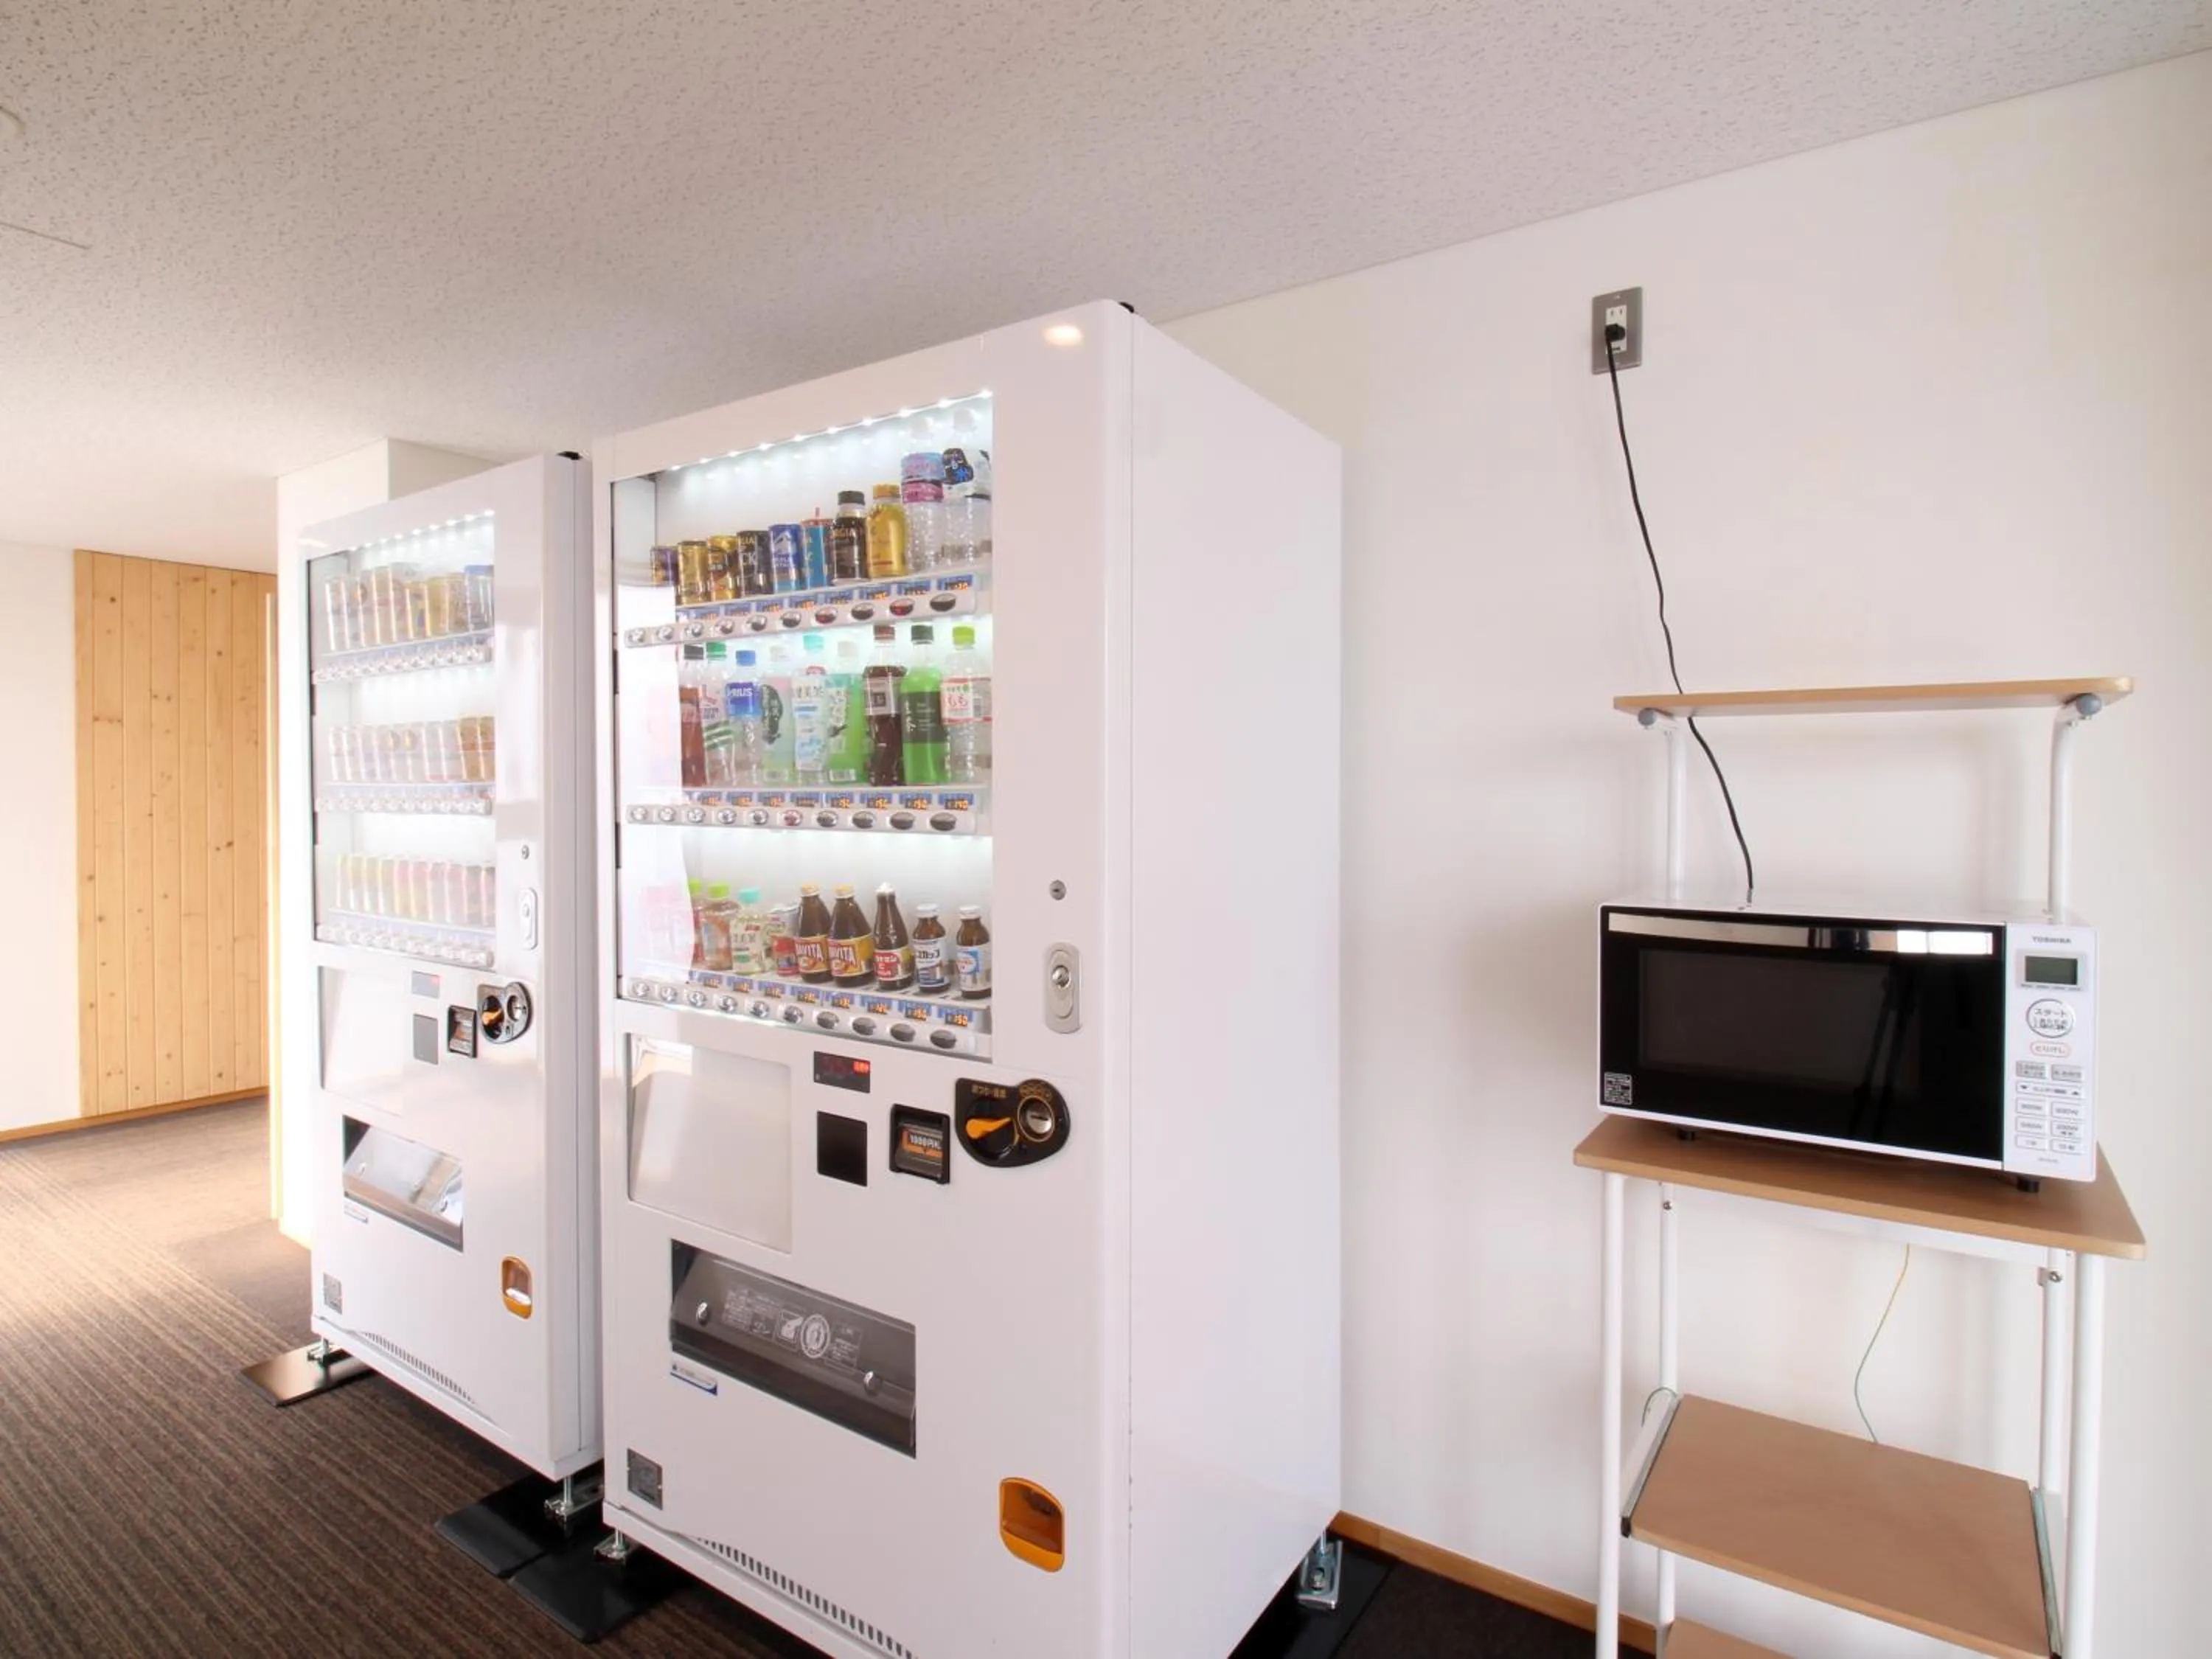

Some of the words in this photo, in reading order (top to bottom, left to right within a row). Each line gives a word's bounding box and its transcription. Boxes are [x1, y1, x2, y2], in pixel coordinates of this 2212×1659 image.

[2032, 936, 2072, 945] TOSHIBA
[2034, 1007, 2067, 1018] スタート
